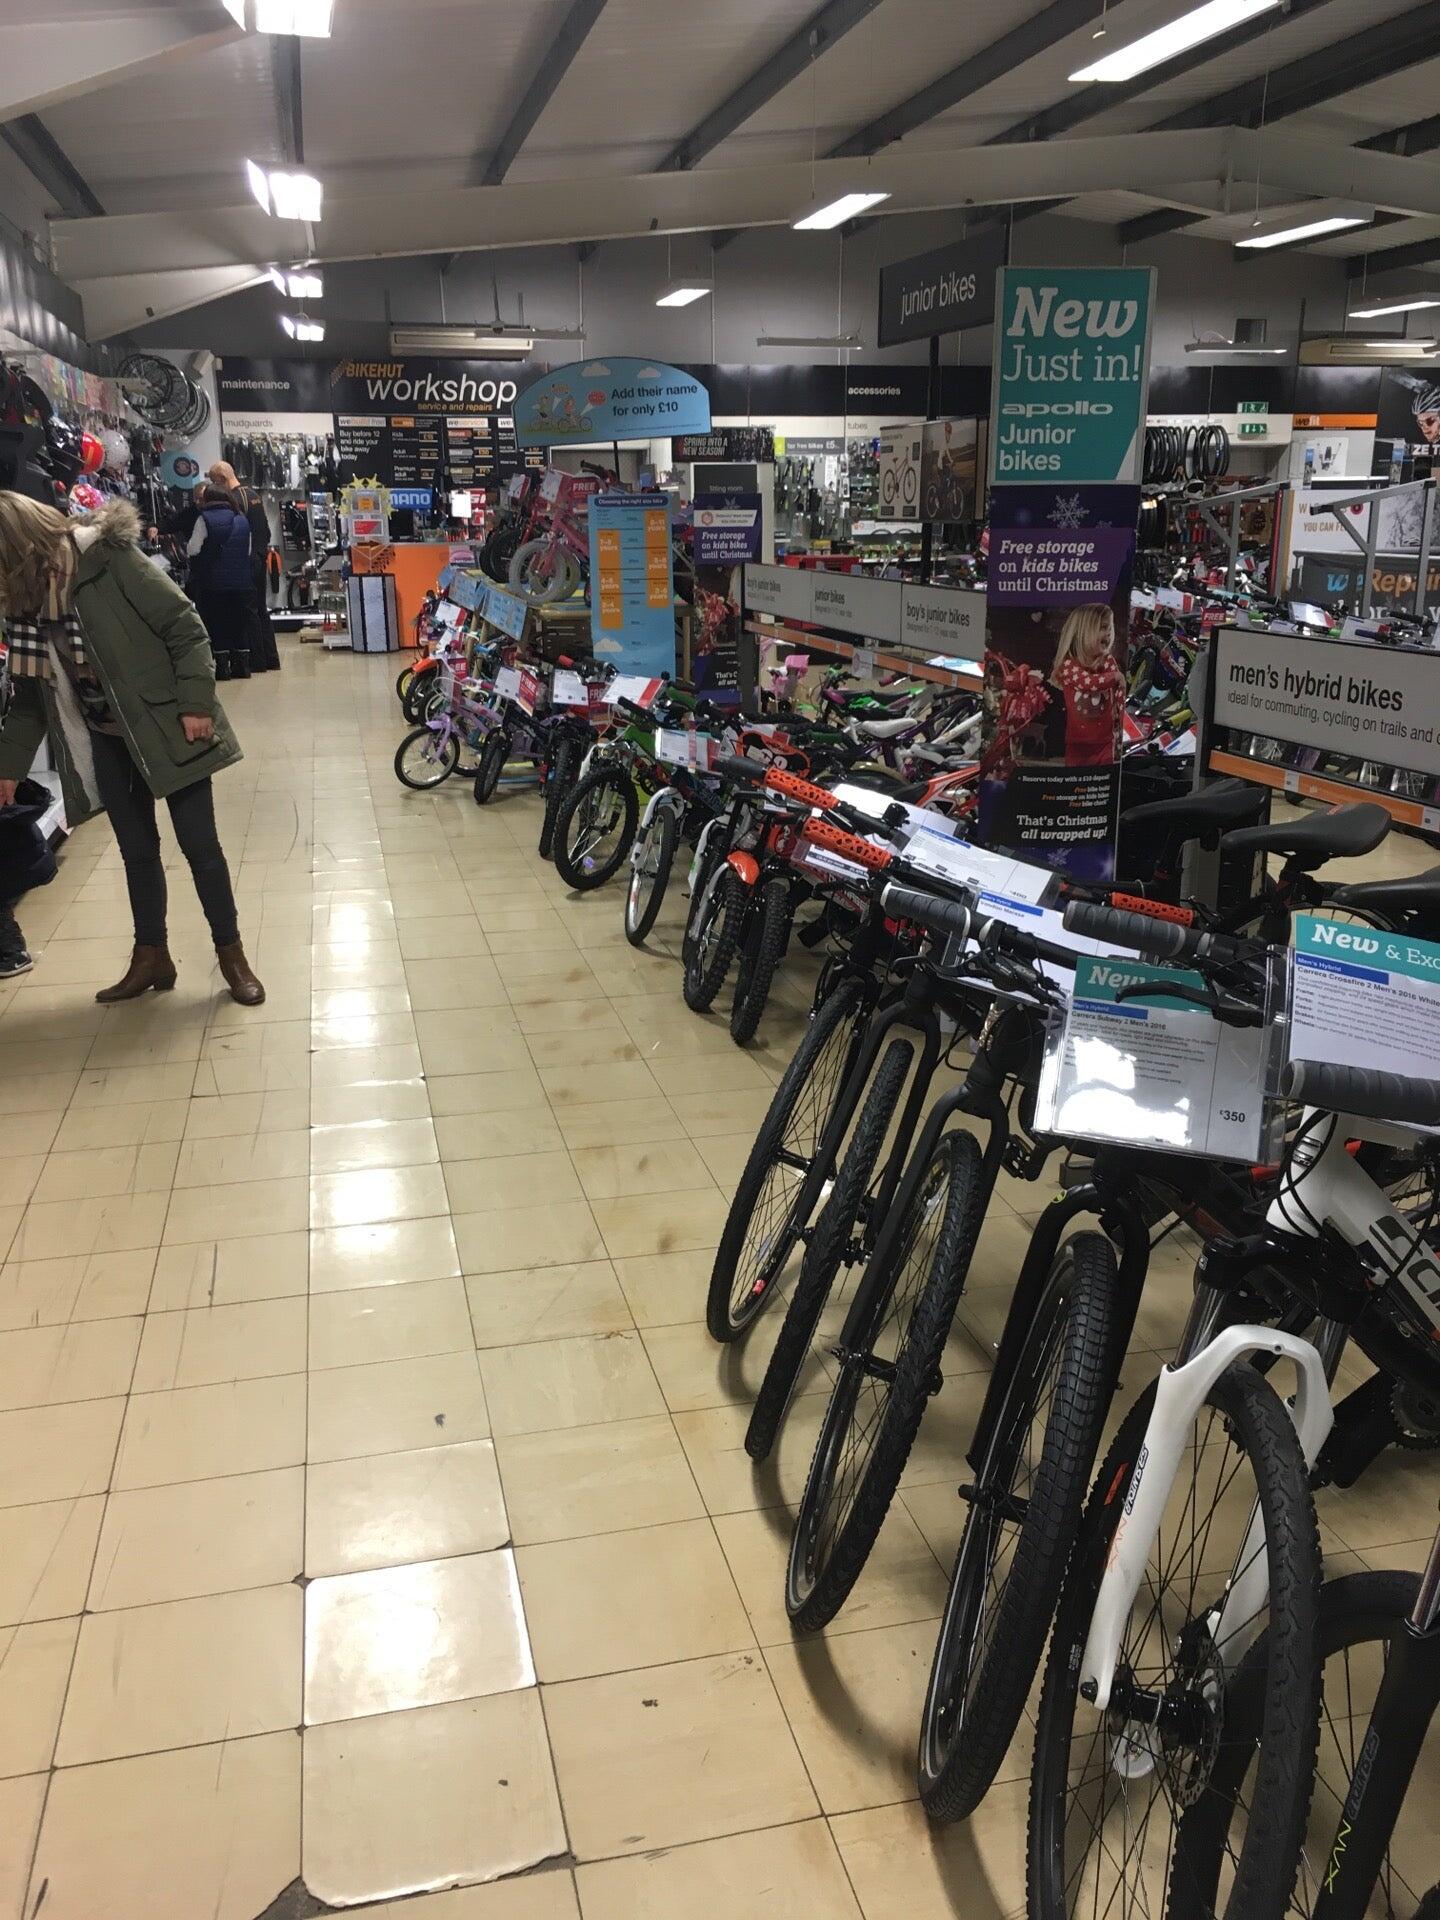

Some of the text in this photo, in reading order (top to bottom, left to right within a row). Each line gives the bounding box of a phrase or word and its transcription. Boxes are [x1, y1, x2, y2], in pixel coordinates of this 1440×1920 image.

[900, 271, 976, 324] junior bikes
[1006, 286, 1138, 338] New
[346, 363, 404, 377] BIKEHUT
[1003, 345, 1140, 382] Just in!
[221, 379, 290, 390] maintenance
[367, 373, 517, 409] workshop
[611, 384, 698, 399] Add their name
[848, 386, 901, 396] accessories
[418, 403, 493, 412] service and repairs
[613, 402, 678, 416] for only £10
[1002, 400, 1113, 418] apollo
[225, 418, 273, 429] mudguards
[847, 422, 868, 430] tubes
[340, 430, 351, 438] Buy
[684, 437, 706, 446] SPRING
[1000, 423, 1076, 445] Junior
[683, 447, 697, 455] NEW
[999, 450, 1061, 471] bikes
[573, 482, 596, 491] FREE
[1304, 522, 1333, 532] YOU CAN
[702, 532, 745, 541] Free storage
[713, 540, 728, 550] kids
[729, 541, 748, 549] bikes
[1000, 541, 1095, 556] Free storage
[702, 551, 752, 559] until Christmas
[999, 558, 1098, 573] on kids bikes
[998, 577, 1108, 592] until Christmas
[814, 587, 845, 604] junior bikes
[906, 602, 970, 627] boy's junior bikes
[1204, 612, 1225, 621] FREE
[522, 675, 537, 691] FREE
[1229, 663, 1403, 711] men's hybrid bikes
[1228, 690, 1433, 743] ideal for commuting, cycling on trails and
[1017, 815, 1107, 826] That's Christmas
[1021, 826, 1107, 841] all wrapped up!
[1311, 923, 1379, 954] New
[1386, 945, 1401, 960] &
[1298, 957, 1342, 972] Men's Hybrid
[1298, 966, 1327, 978] Carrera
[1329, 972, 1366, 987] Crossfire
[1374, 984, 1397, 995] Men's
[1398, 990, 1416, 1000] 2016
[1072, 1011, 1096, 1020] Carrera
[1097, 1014, 1123, 1025] Subway
[1130, 1019, 1149, 1028] Men's
[1150, 1022, 1166, 1030] 2016
[1219, 1110, 1246, 1123] £350
[1125, 1467, 1144, 1516] SUNTOUR
[1324, 1818, 1351, 1895] NVX
